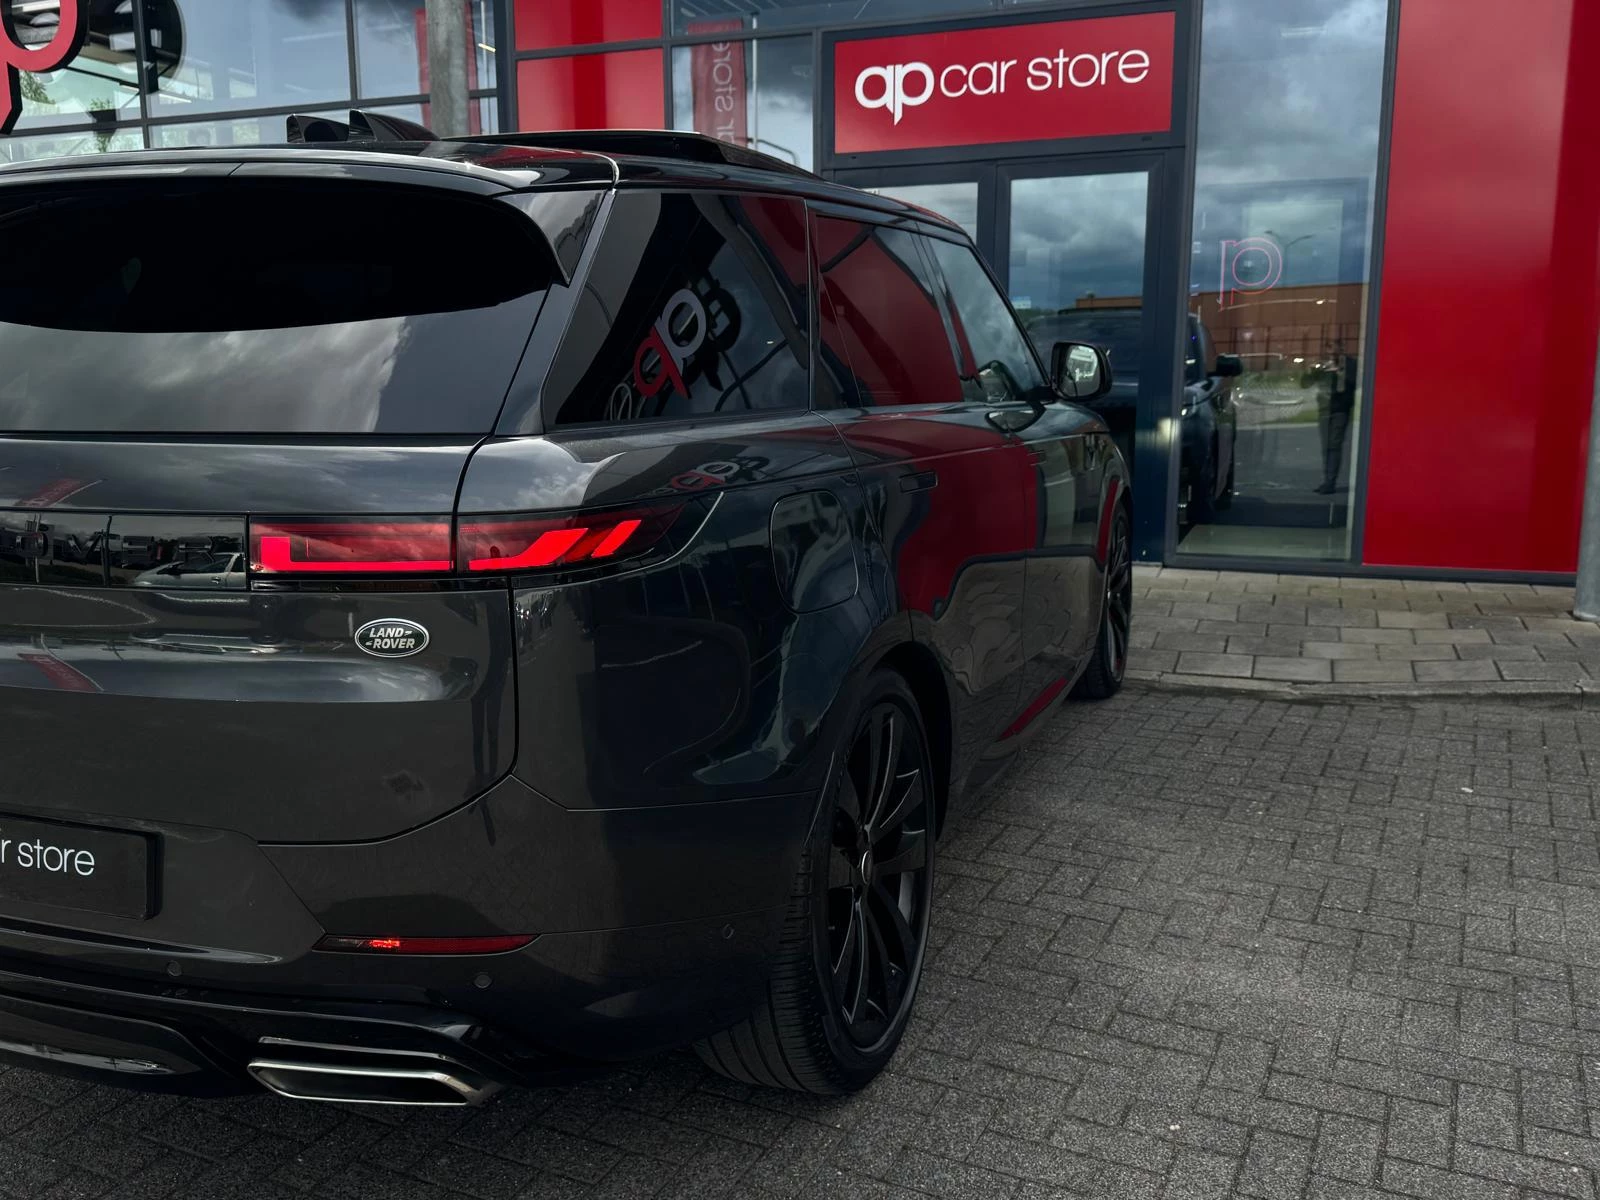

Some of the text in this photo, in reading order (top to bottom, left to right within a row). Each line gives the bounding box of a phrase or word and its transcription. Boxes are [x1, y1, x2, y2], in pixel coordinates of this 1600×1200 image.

[939, 59, 1017, 98] car
[1026, 48, 1150, 92] store
[369, 627, 404, 638] LAND
[372, 638, 416, 649] ROVER
[17, 838, 96, 876] store
